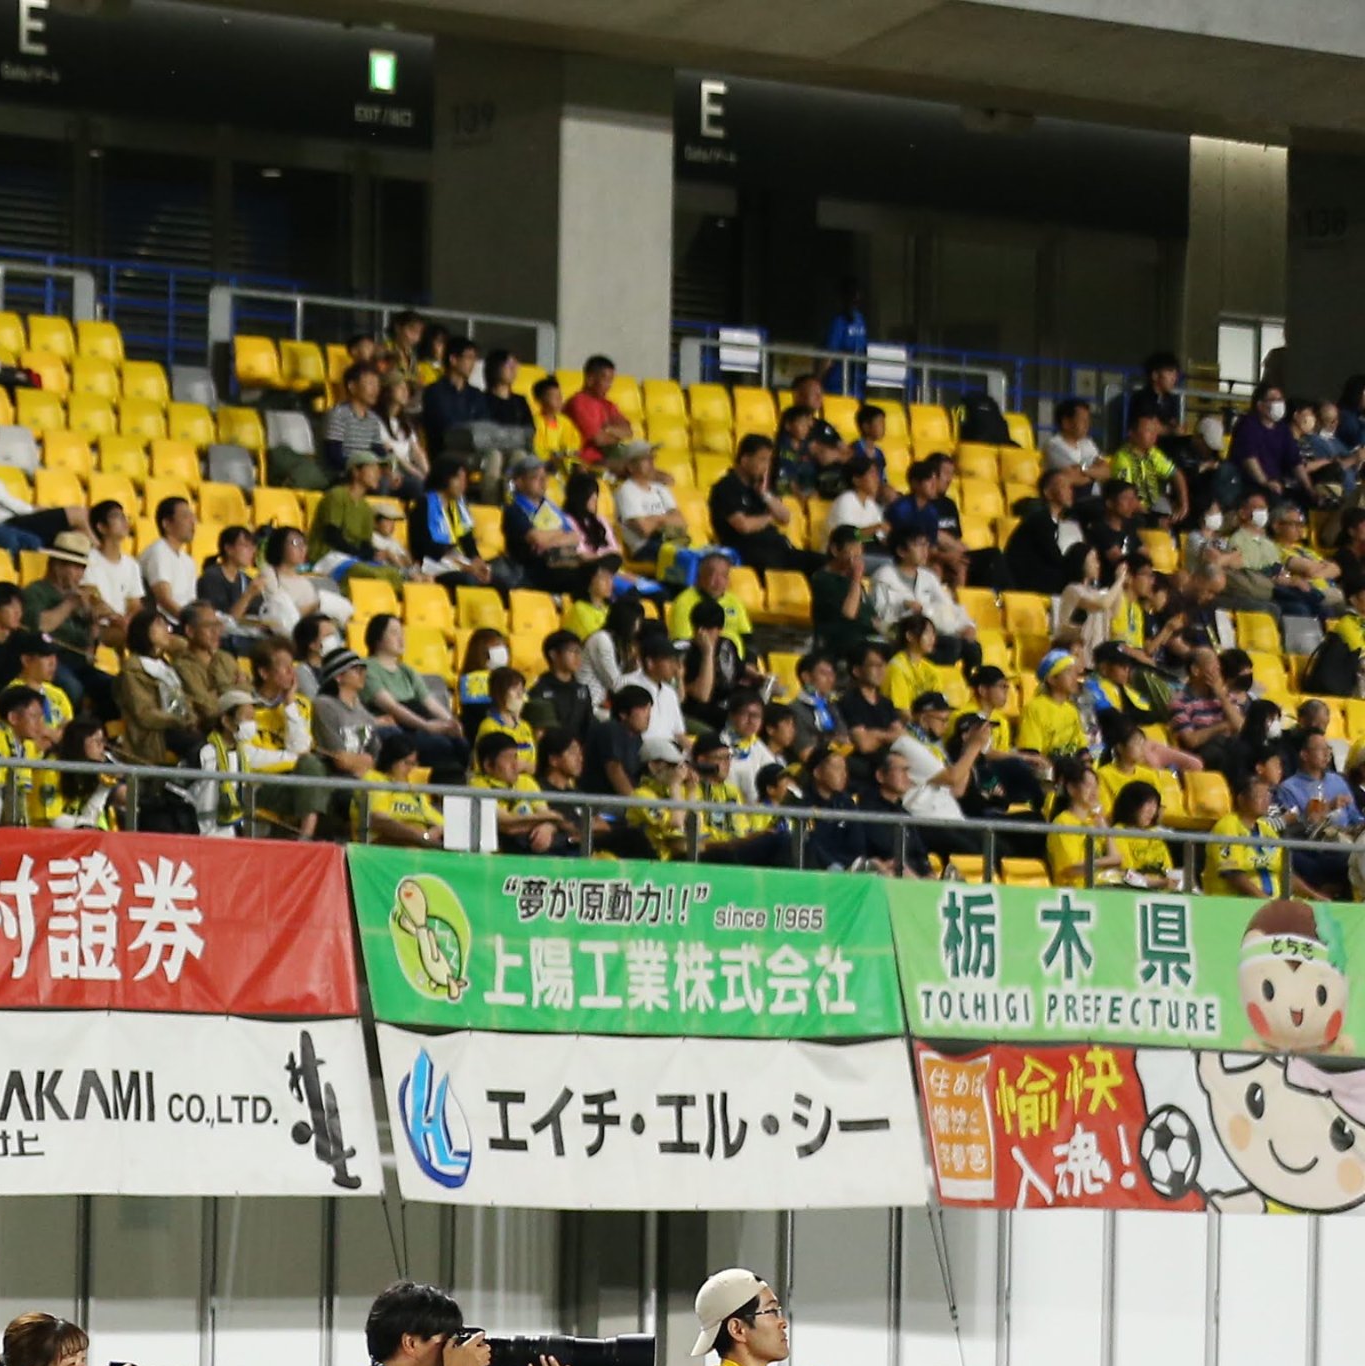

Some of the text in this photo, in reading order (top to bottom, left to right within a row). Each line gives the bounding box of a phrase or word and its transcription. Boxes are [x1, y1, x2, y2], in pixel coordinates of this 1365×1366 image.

[17, 0, 52, 55] E
[699, 78, 730, 139] E
[713, 903, 766, 930] since
[772, 904, 825, 931] 1965
[940, 889, 1192, 988] 栃木県
[483, 934, 856, 1015] 上陽工業株式会社
[921, 989, 1217, 1032] TOCHIGI PREFECTURE
[167, 1092, 279, 1129] CO.,LTD.
[995, 1046, 1124, 1139] 愉快
[485, 1087, 891, 1160] エイチ・エル・シー
